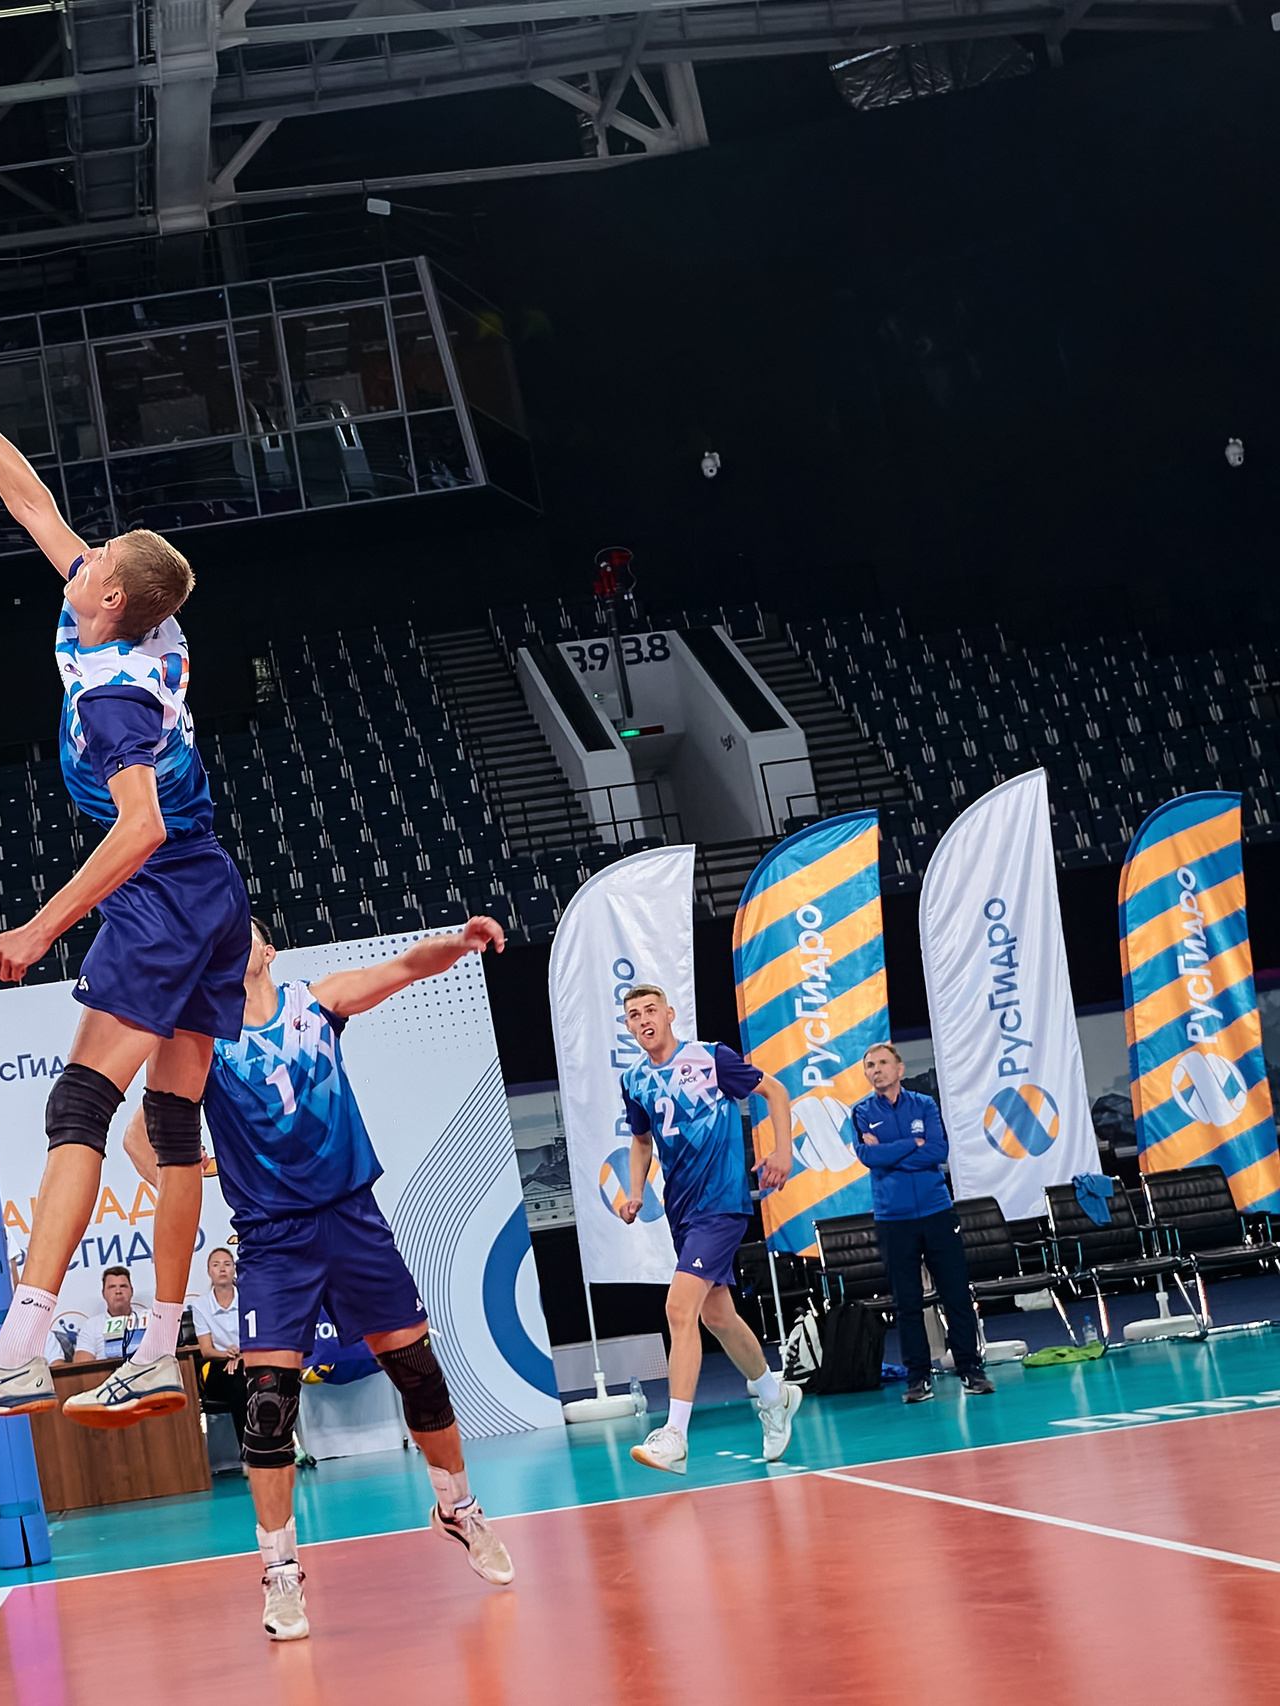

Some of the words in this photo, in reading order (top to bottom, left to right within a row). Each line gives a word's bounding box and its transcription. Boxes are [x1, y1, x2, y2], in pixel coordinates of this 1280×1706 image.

[566, 642, 610, 673] 3.9
[621, 633, 671, 666] 3.8
[1175, 866, 1224, 1044] РусГидро
[795, 904, 841, 1088] РусГидро
[983, 897, 1034, 1078] РусГидро
[265, 1064, 297, 1115] 1
[654, 1096, 680, 1138] 2
[107, 1319, 123, 1333] 12
[244, 1310, 257, 1338] 1
